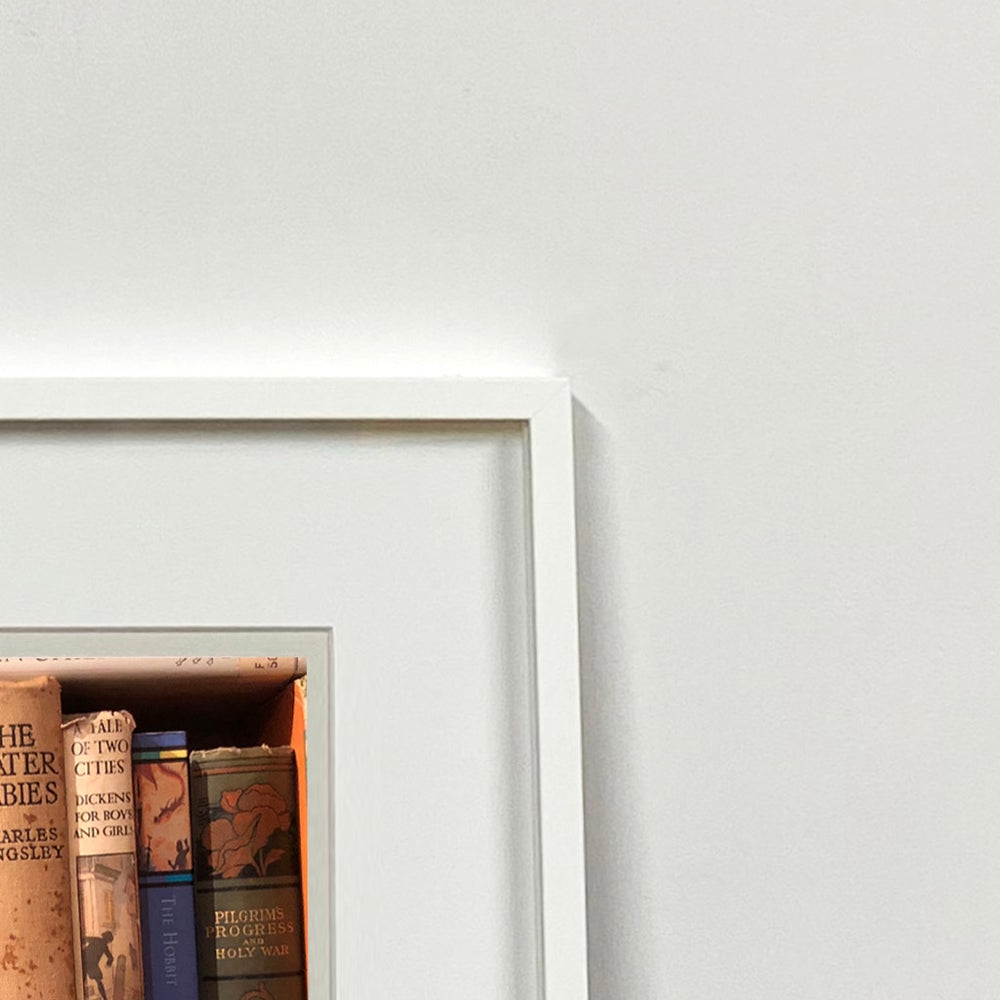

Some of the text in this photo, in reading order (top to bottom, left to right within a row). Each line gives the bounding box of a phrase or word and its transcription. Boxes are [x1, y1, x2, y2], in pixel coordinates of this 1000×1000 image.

[71, 738, 130, 756] OF TWO
[74, 760, 126, 777] CITIES
[76, 791, 132, 806] DICKENS
[75, 810, 100, 823] FOR
[74, 827, 100, 839] AND
[161, 896, 177, 926] THE
[205, 921, 295, 938] PROGRESS
[243, 938, 265, 946] AND
[216, 945, 290, 960] HOLY WAR
